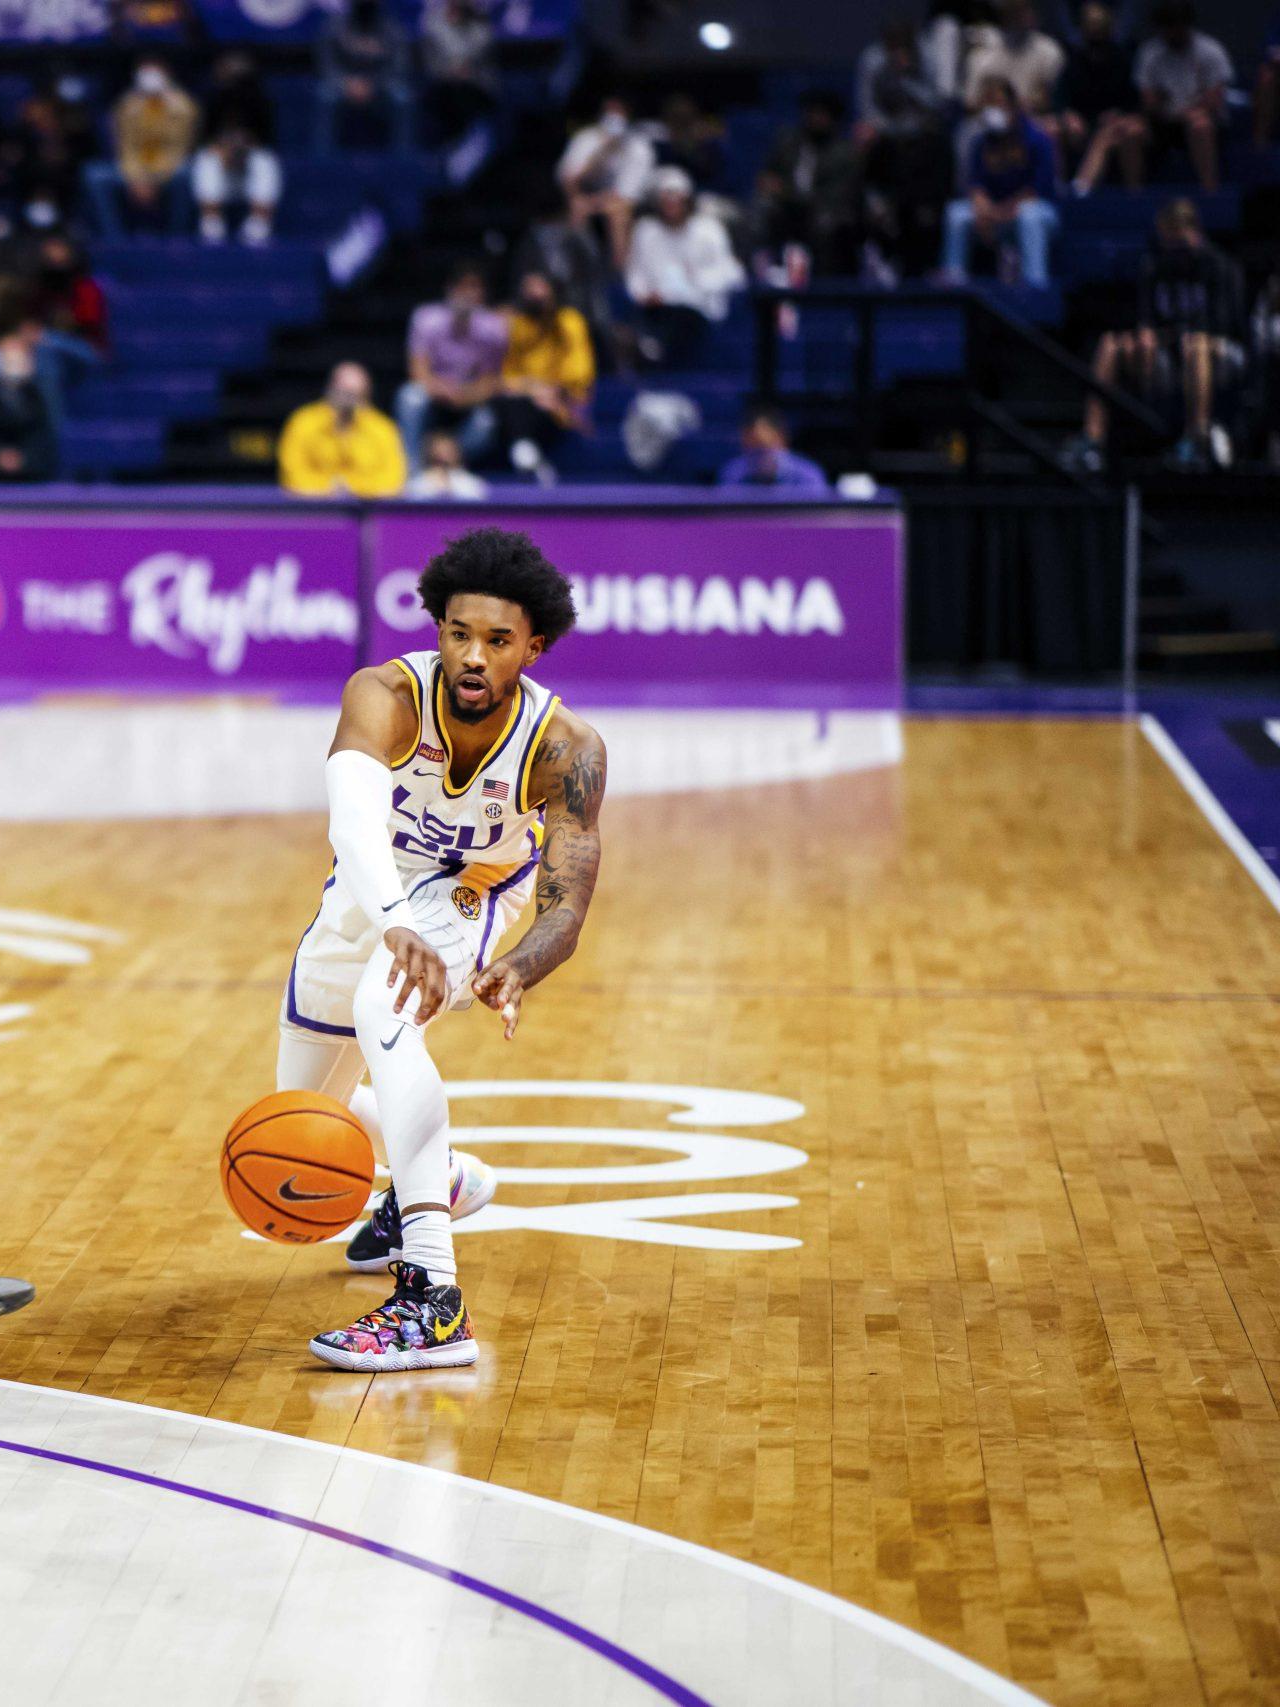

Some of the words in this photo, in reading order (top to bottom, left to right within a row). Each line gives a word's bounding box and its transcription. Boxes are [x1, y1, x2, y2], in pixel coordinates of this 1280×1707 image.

[23, 580, 109, 634] THE
[122, 553, 358, 672] Rhythm
[375, 568, 432, 632] O
[571, 572, 845, 636] UISIANA
[392, 784, 504, 851] LSU
[485, 806, 502, 818] SEC
